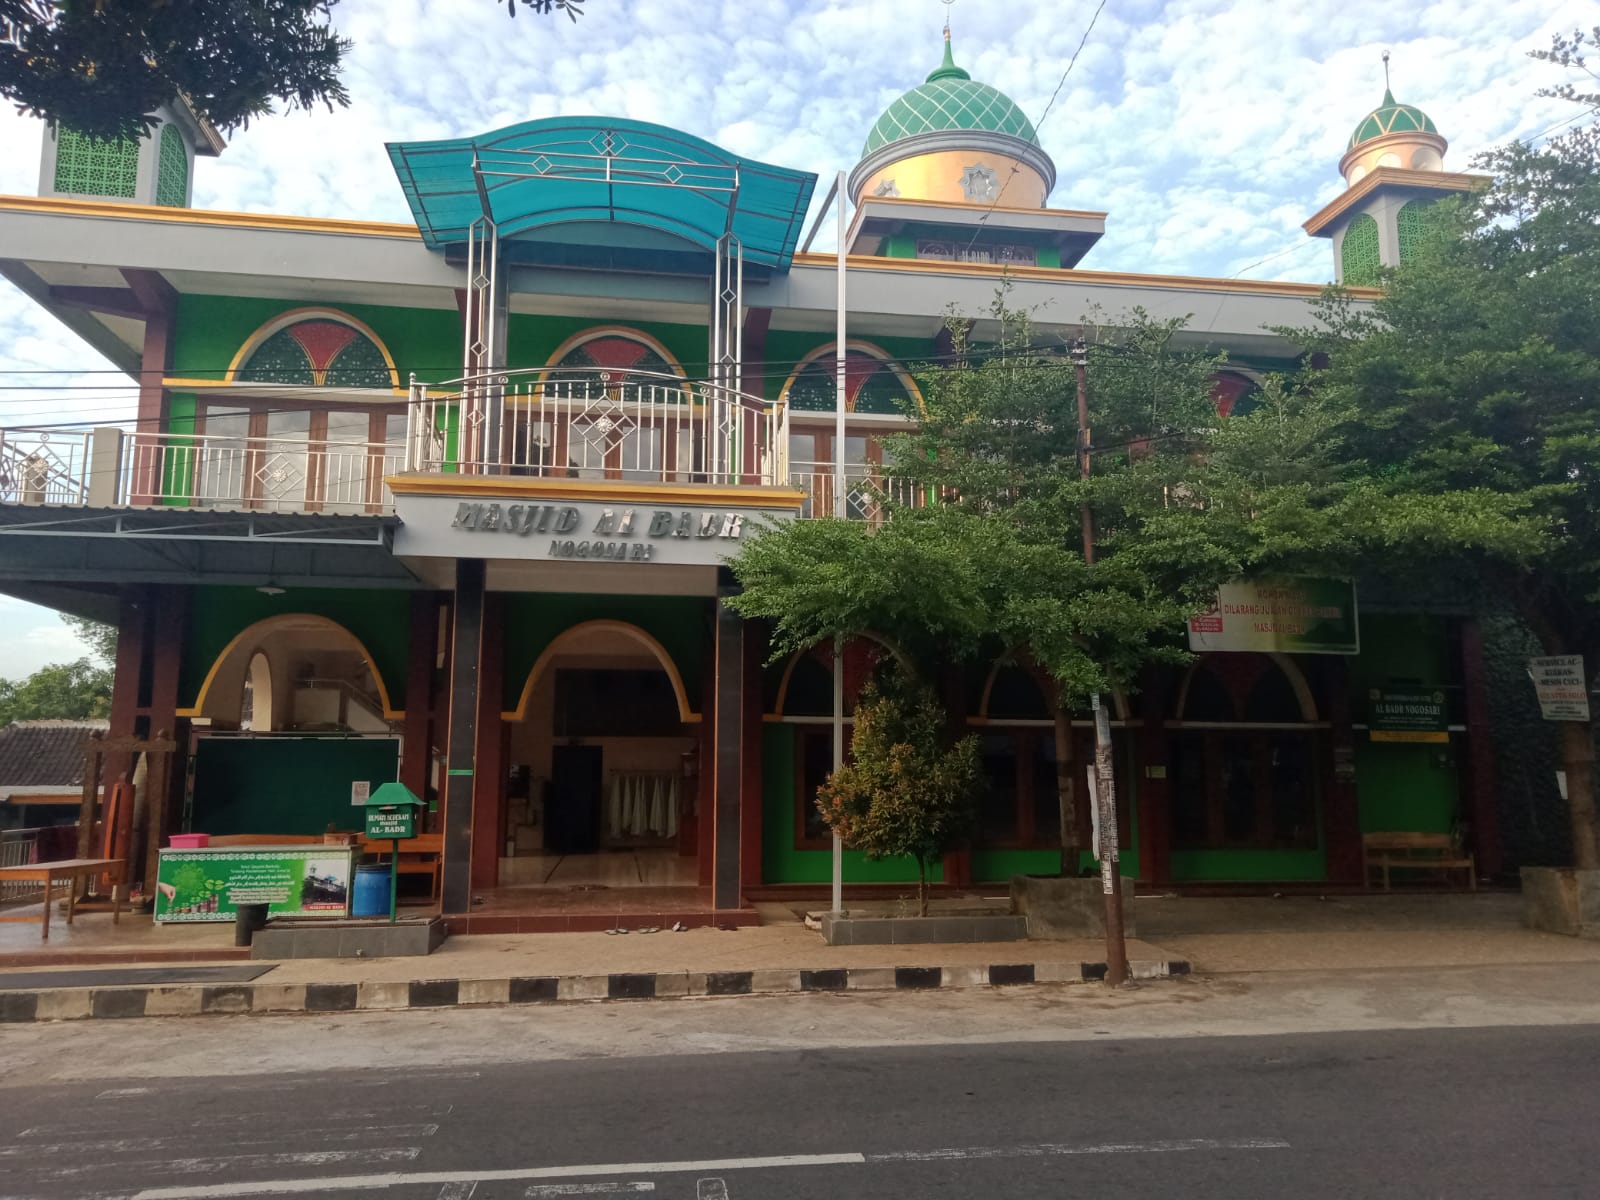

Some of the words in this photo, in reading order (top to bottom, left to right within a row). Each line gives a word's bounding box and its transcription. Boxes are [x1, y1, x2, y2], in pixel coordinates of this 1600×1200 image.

[451, 502, 581, 536] MASJID
[648, 509, 745, 539] BADR
[549, 539, 655, 561] NOGOSARI
[1224, 604, 1259, 616] DILARANG
[384, 825, 406, 833] BADR
